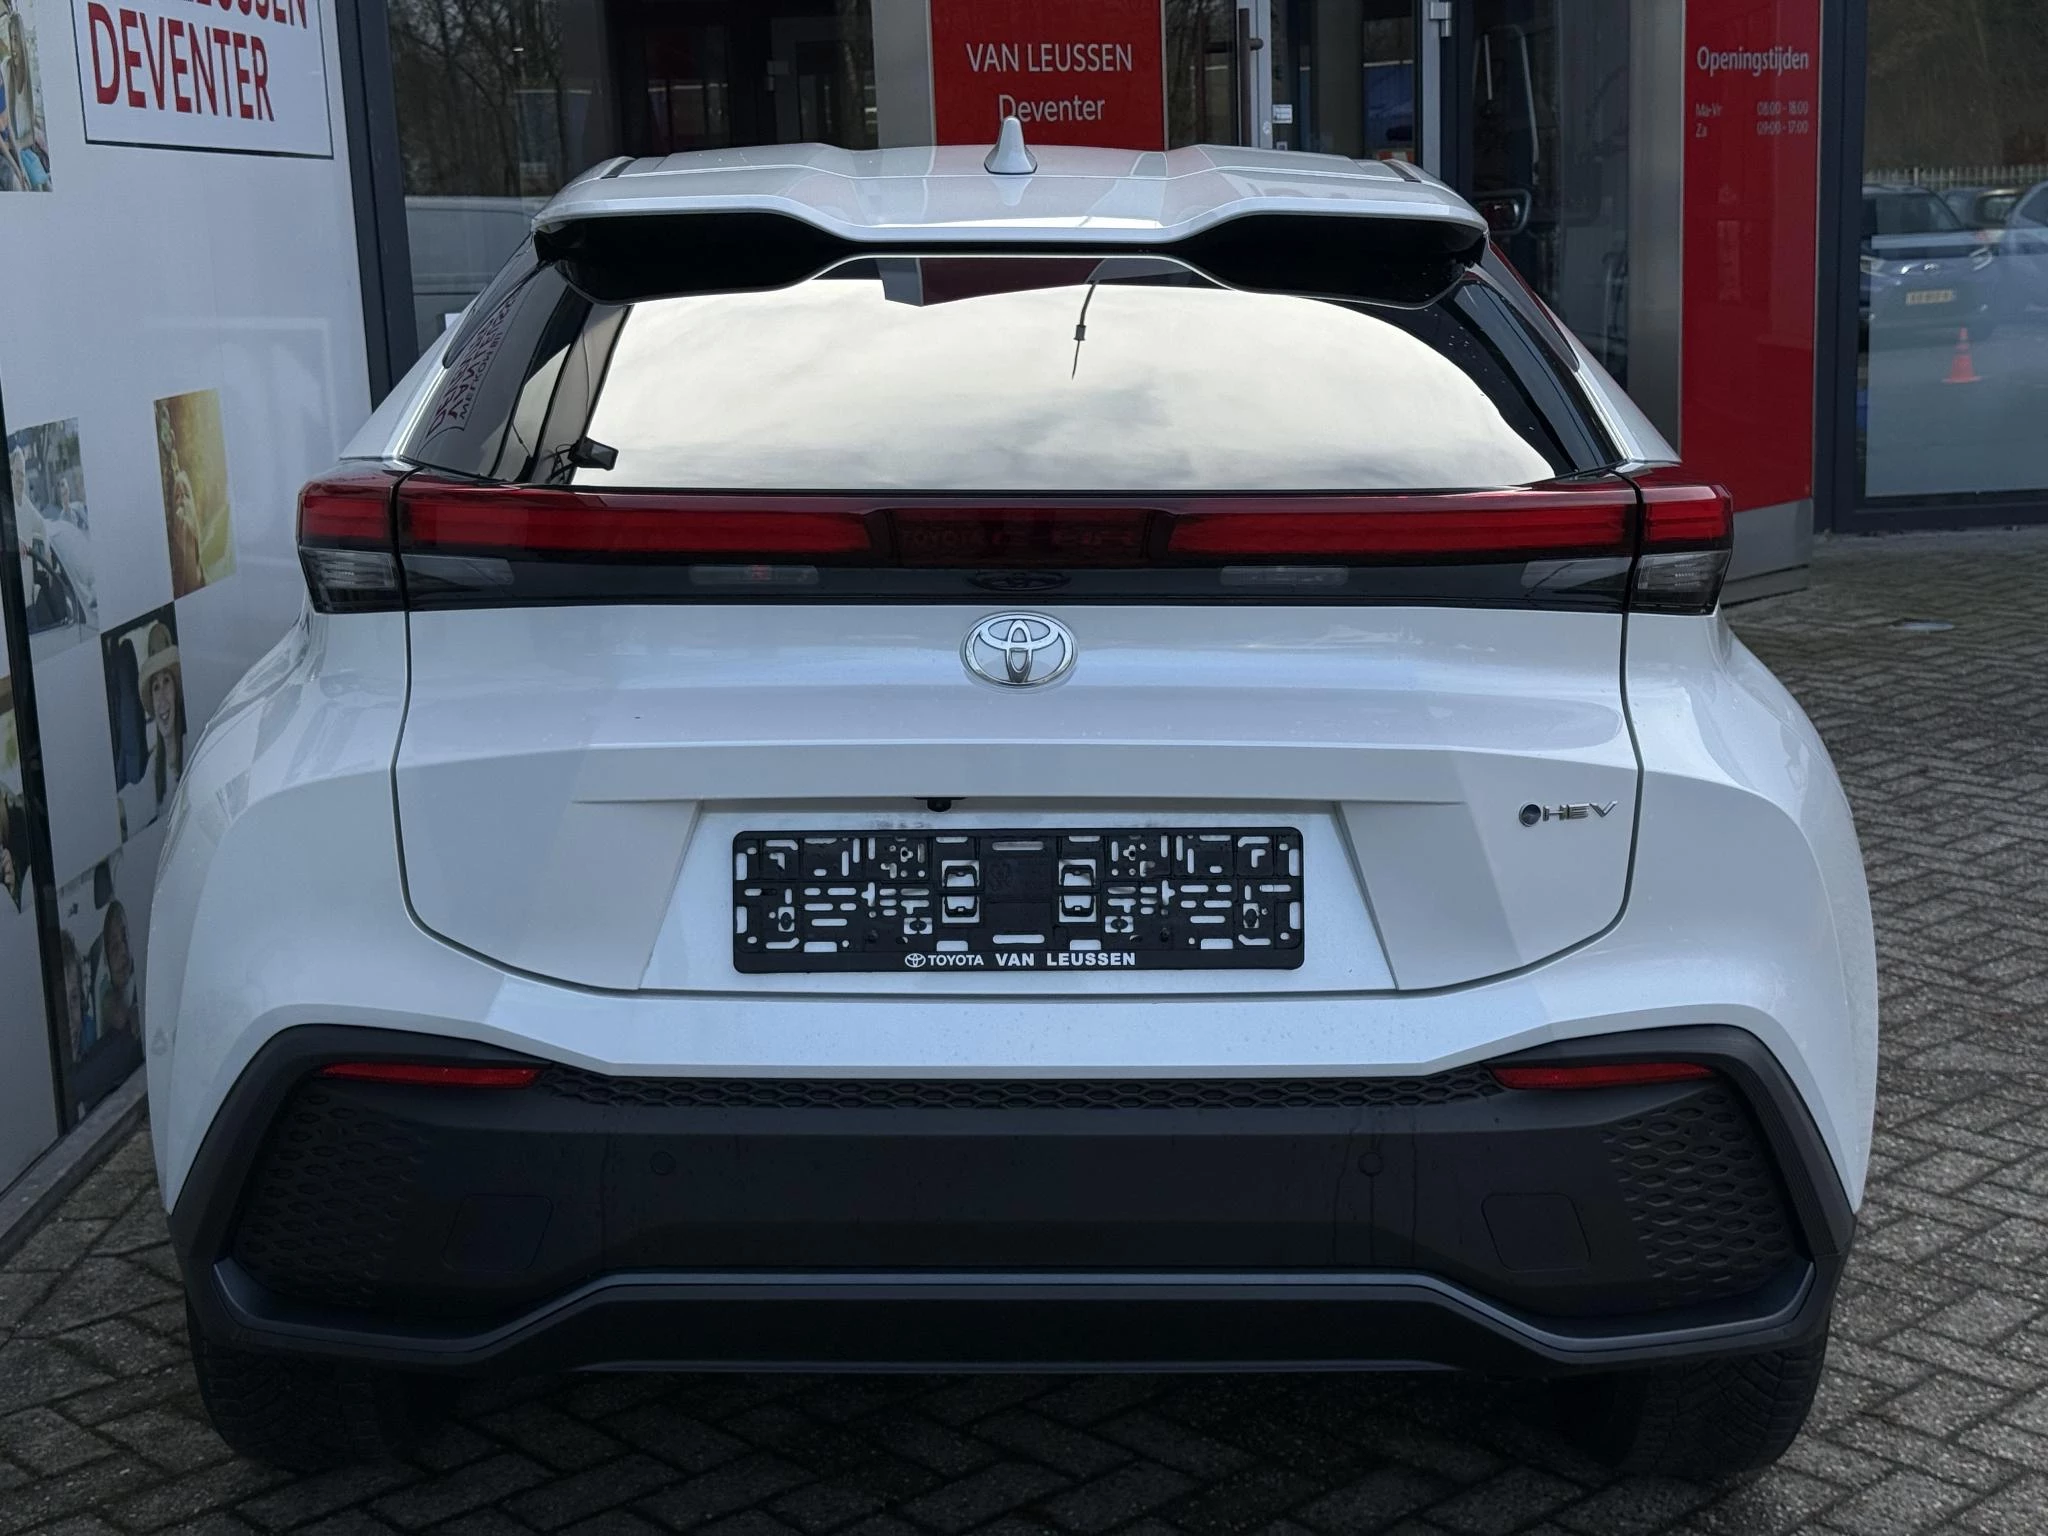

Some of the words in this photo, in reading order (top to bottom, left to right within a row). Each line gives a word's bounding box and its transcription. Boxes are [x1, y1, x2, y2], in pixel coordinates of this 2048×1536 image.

[88, 2, 275, 121] DEVENTER
[966, 43, 1018, 72] VAN
[1028, 43, 1133, 72] LEUSSEN
[1696, 46, 1809, 77] Openingstijden
[999, 94, 1105, 121] Deventer
[1542, 800, 1618, 821] HEV
[928, 954, 984, 966] TOYOTA
[995, 953, 1035, 967] VAN
[1046, 953, 1136, 967] LEUSSEN
